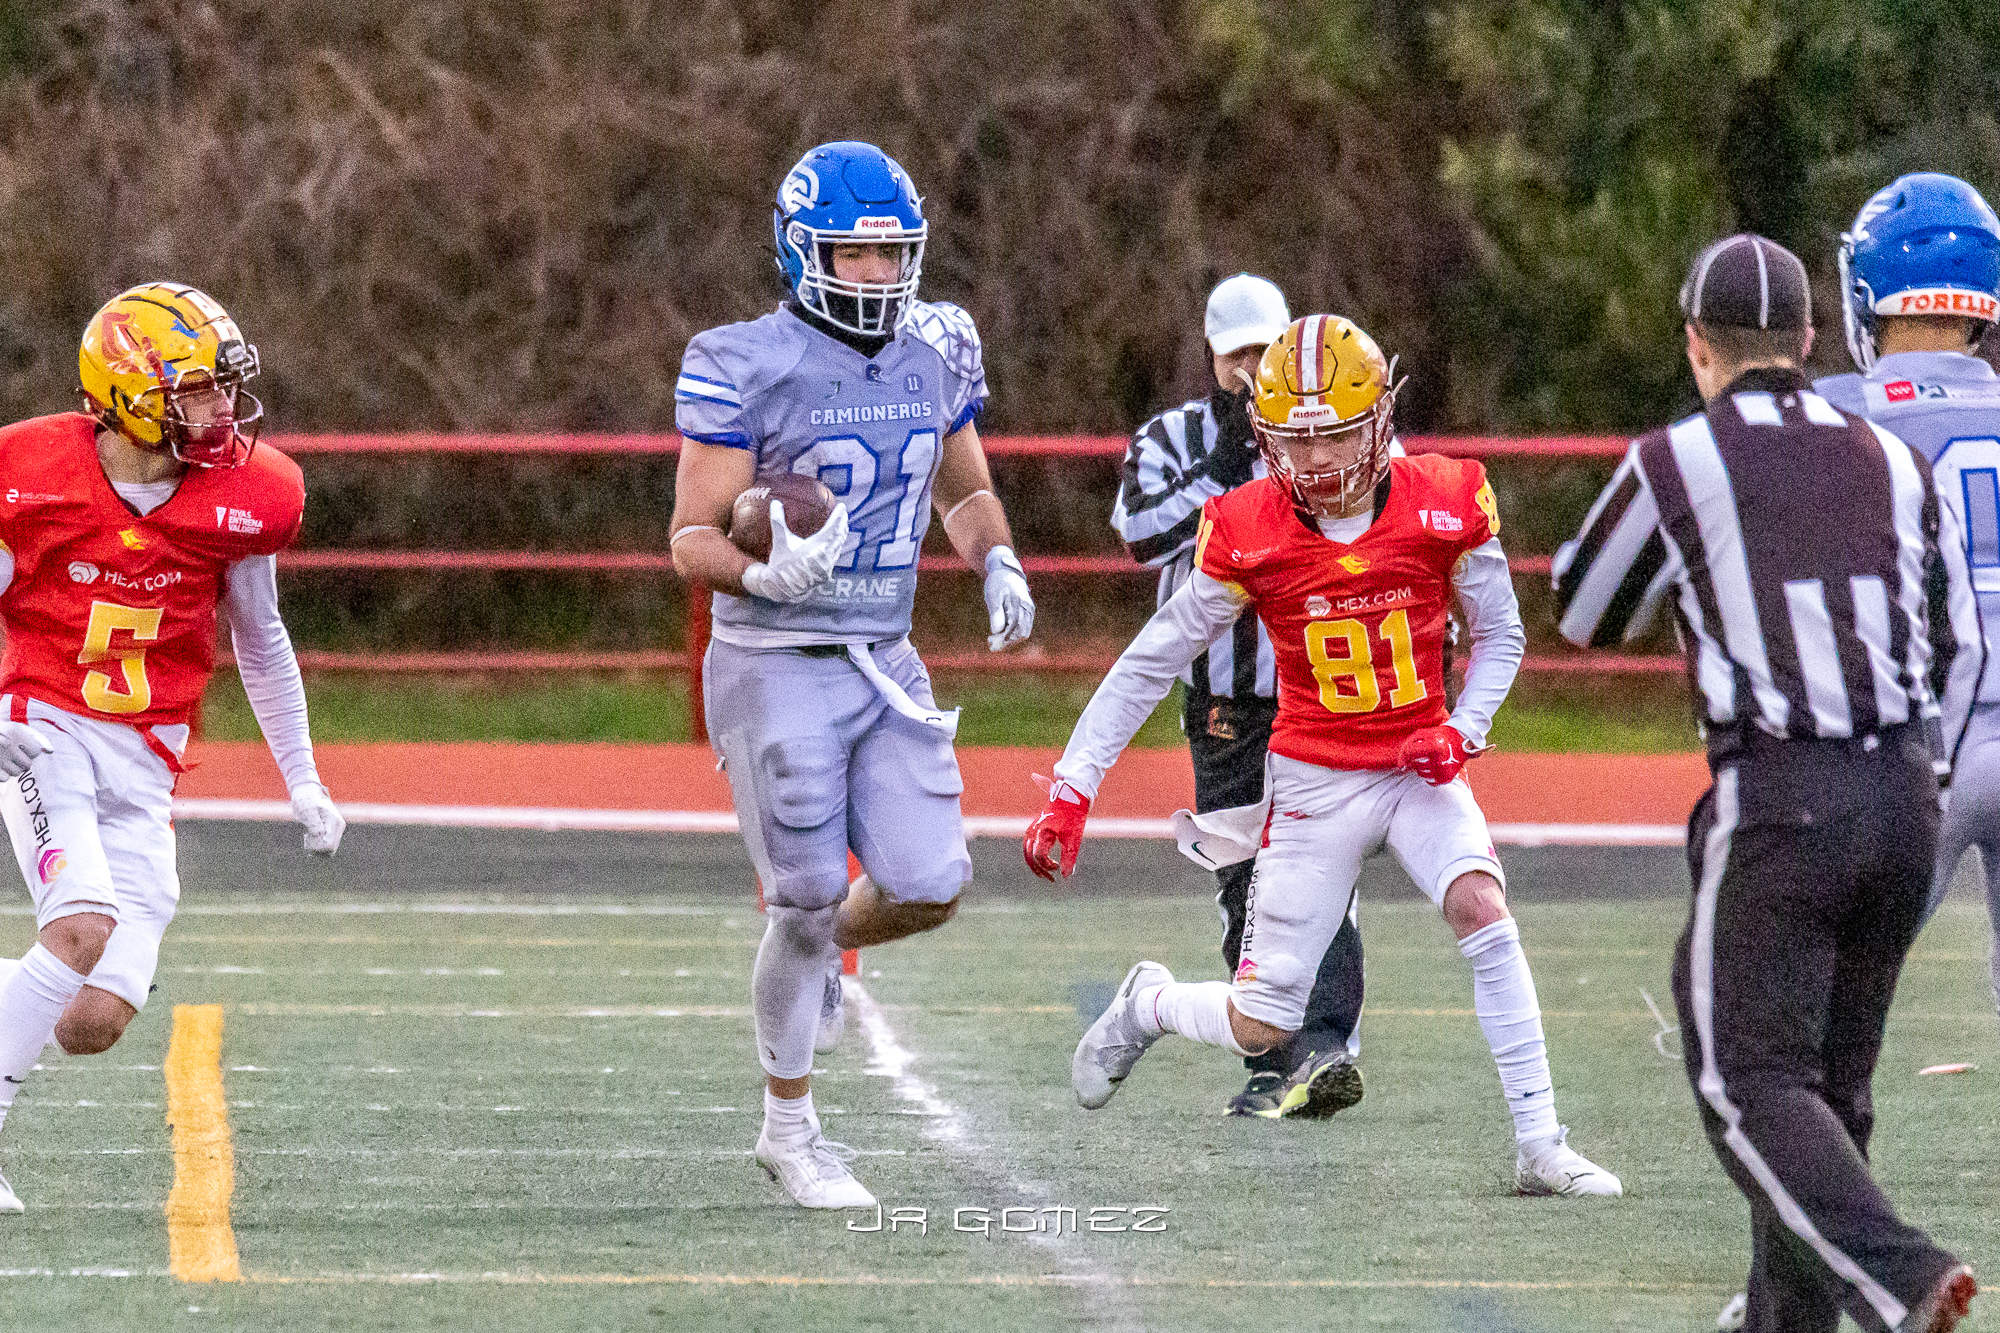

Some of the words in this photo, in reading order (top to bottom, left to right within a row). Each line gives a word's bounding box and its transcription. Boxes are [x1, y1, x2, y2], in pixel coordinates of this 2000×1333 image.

[861, 219, 898, 228] Riddell
[810, 401, 932, 425] CAMIONEROS
[788, 427, 937, 571] 21
[1336, 586, 1412, 611] HEX.COM
[77, 600, 165, 714] 5
[1303, 608, 1428, 713] 81
